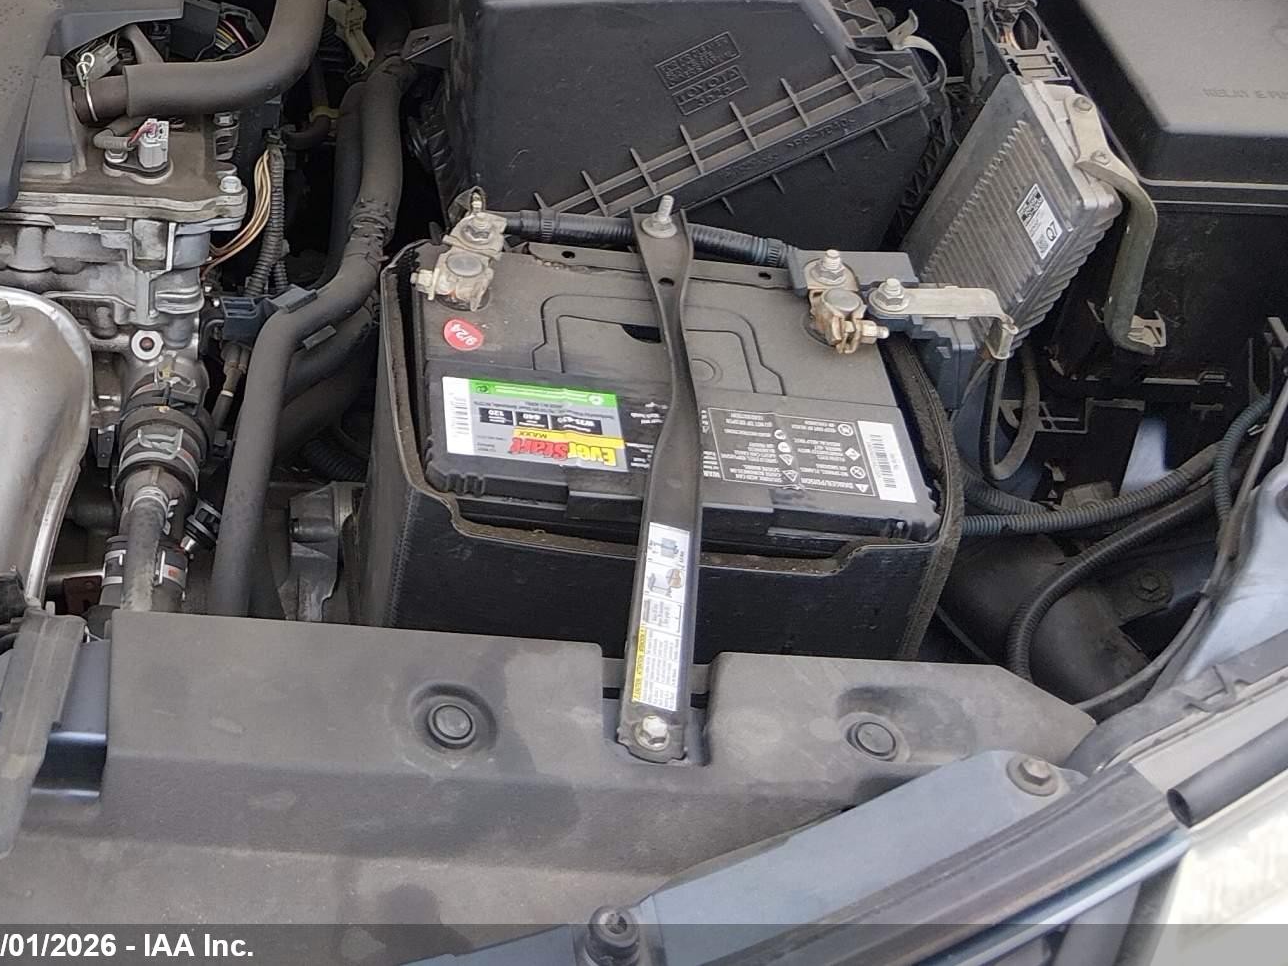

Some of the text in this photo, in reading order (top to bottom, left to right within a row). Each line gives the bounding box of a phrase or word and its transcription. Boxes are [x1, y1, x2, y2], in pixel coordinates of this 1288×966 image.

[675, 68, 740, 103] TOYOTA
[1045, 220, 1058, 242] Q7
[519, 430, 548, 439] MAXX
[509, 436, 618, 467] EverStart
